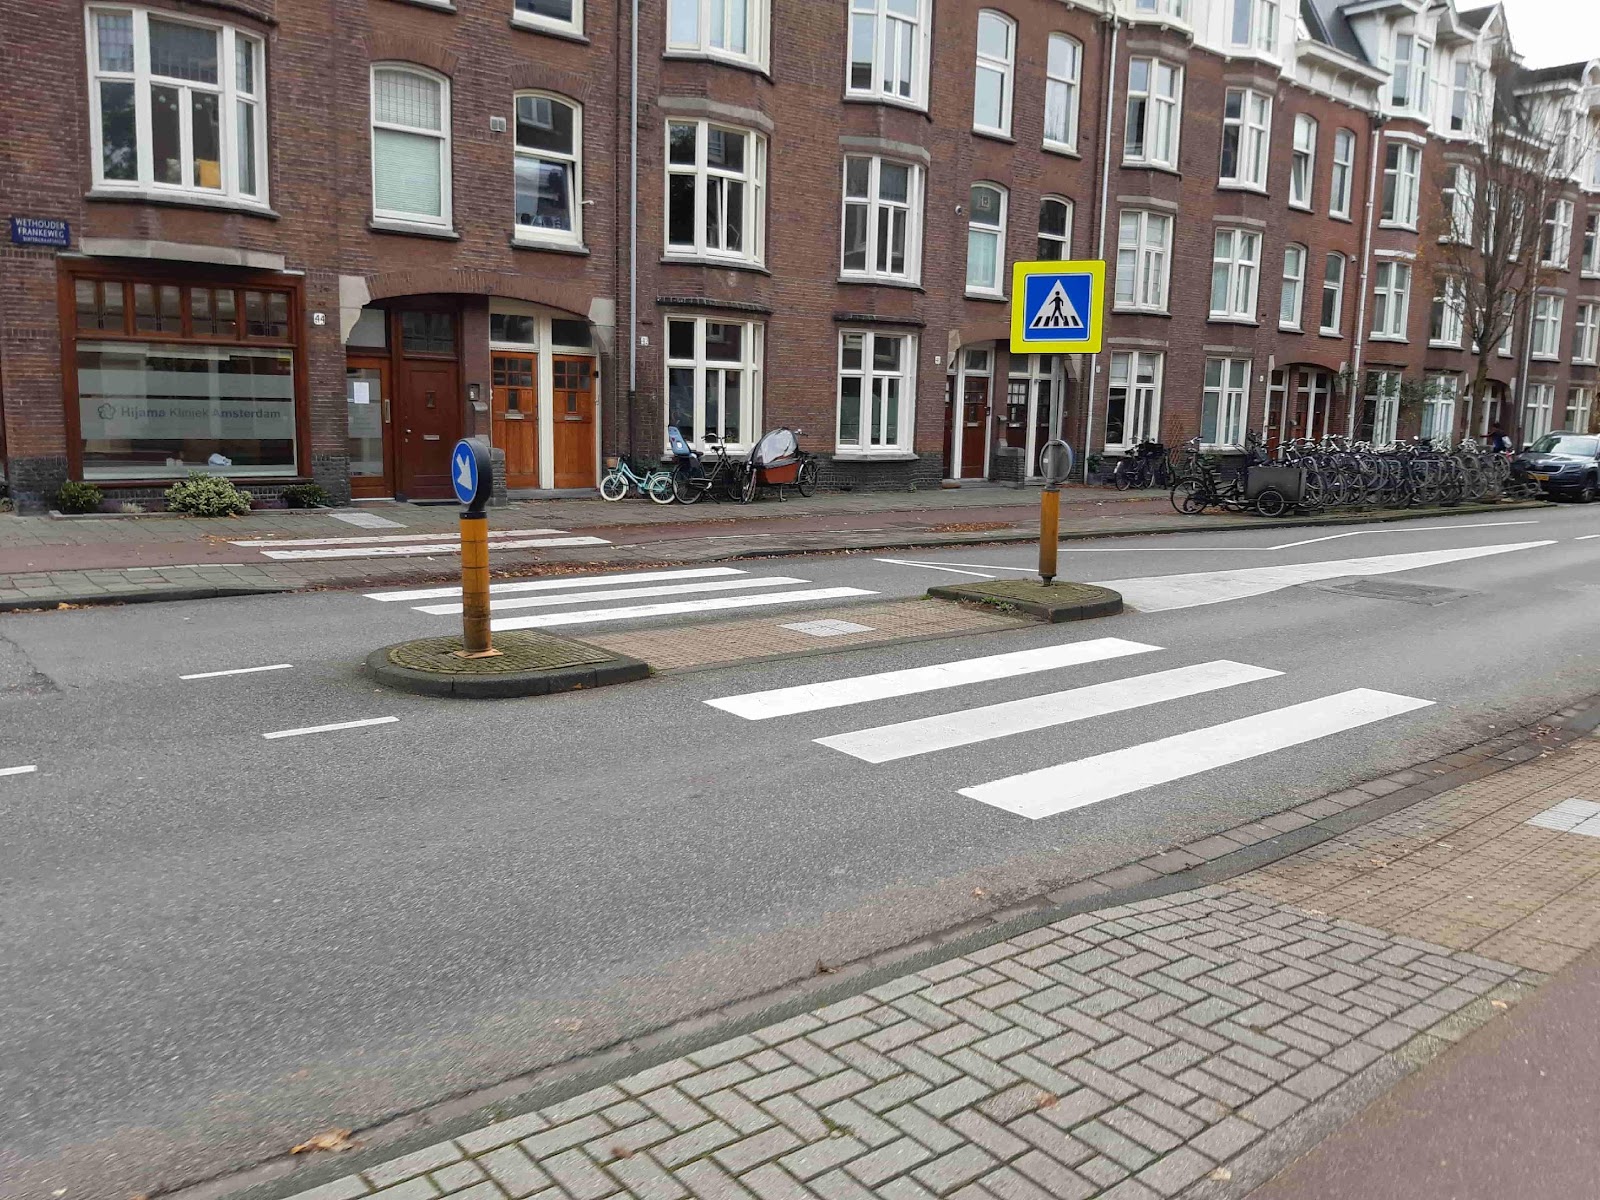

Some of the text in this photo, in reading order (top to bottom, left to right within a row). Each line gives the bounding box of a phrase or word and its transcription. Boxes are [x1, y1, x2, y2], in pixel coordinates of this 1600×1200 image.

[15, 217, 66, 230] WETHOUDER
[18, 226, 64, 238] FRANKEWEG
[121, 406, 281, 420] Hijama Kliniek Amsterdam
